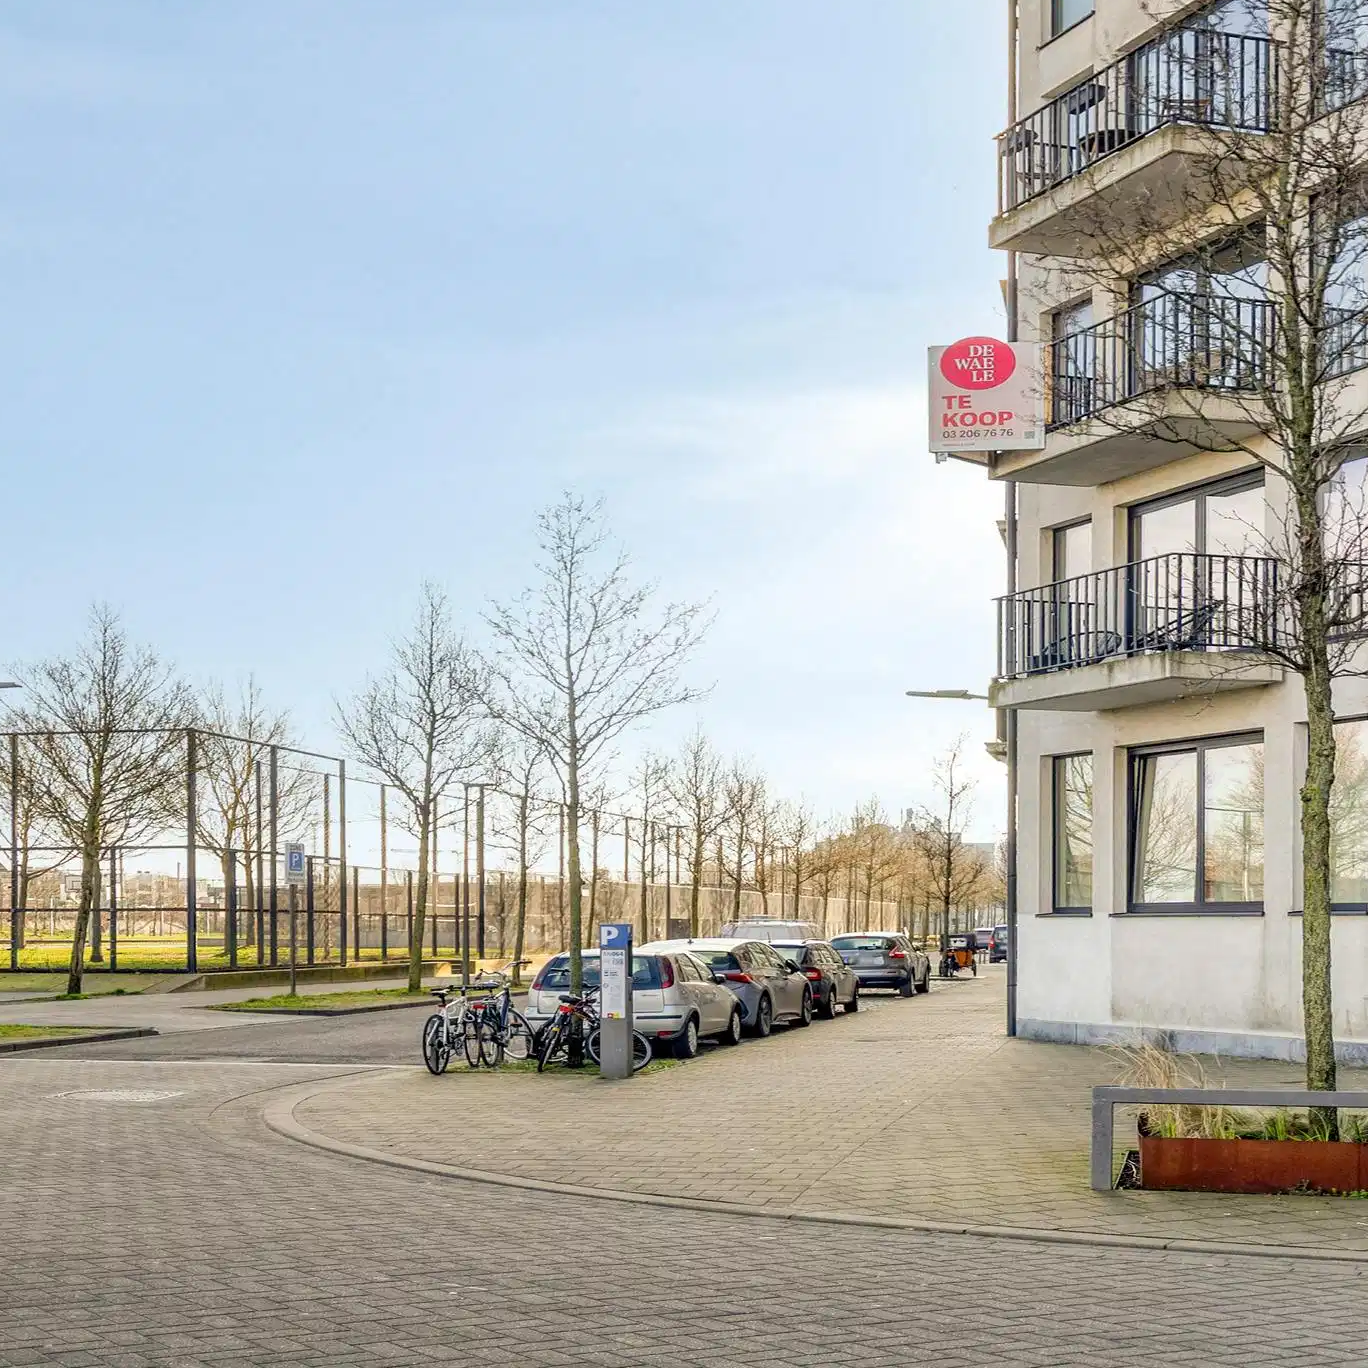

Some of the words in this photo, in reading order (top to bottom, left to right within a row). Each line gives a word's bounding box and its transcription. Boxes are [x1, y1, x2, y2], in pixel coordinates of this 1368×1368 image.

[969, 344, 995, 357] DE
[954, 358, 995, 370] WAE
[972, 370, 995, 383] LE
[941, 395, 972, 409] TE
[942, 411, 1013, 427] KOOP
[942, 430, 957, 439] 03
[959, 429, 981, 438] 206
[983, 428, 997, 437] 76
[1000, 428, 1014, 437] 76
[600, 926, 619, 946] P
